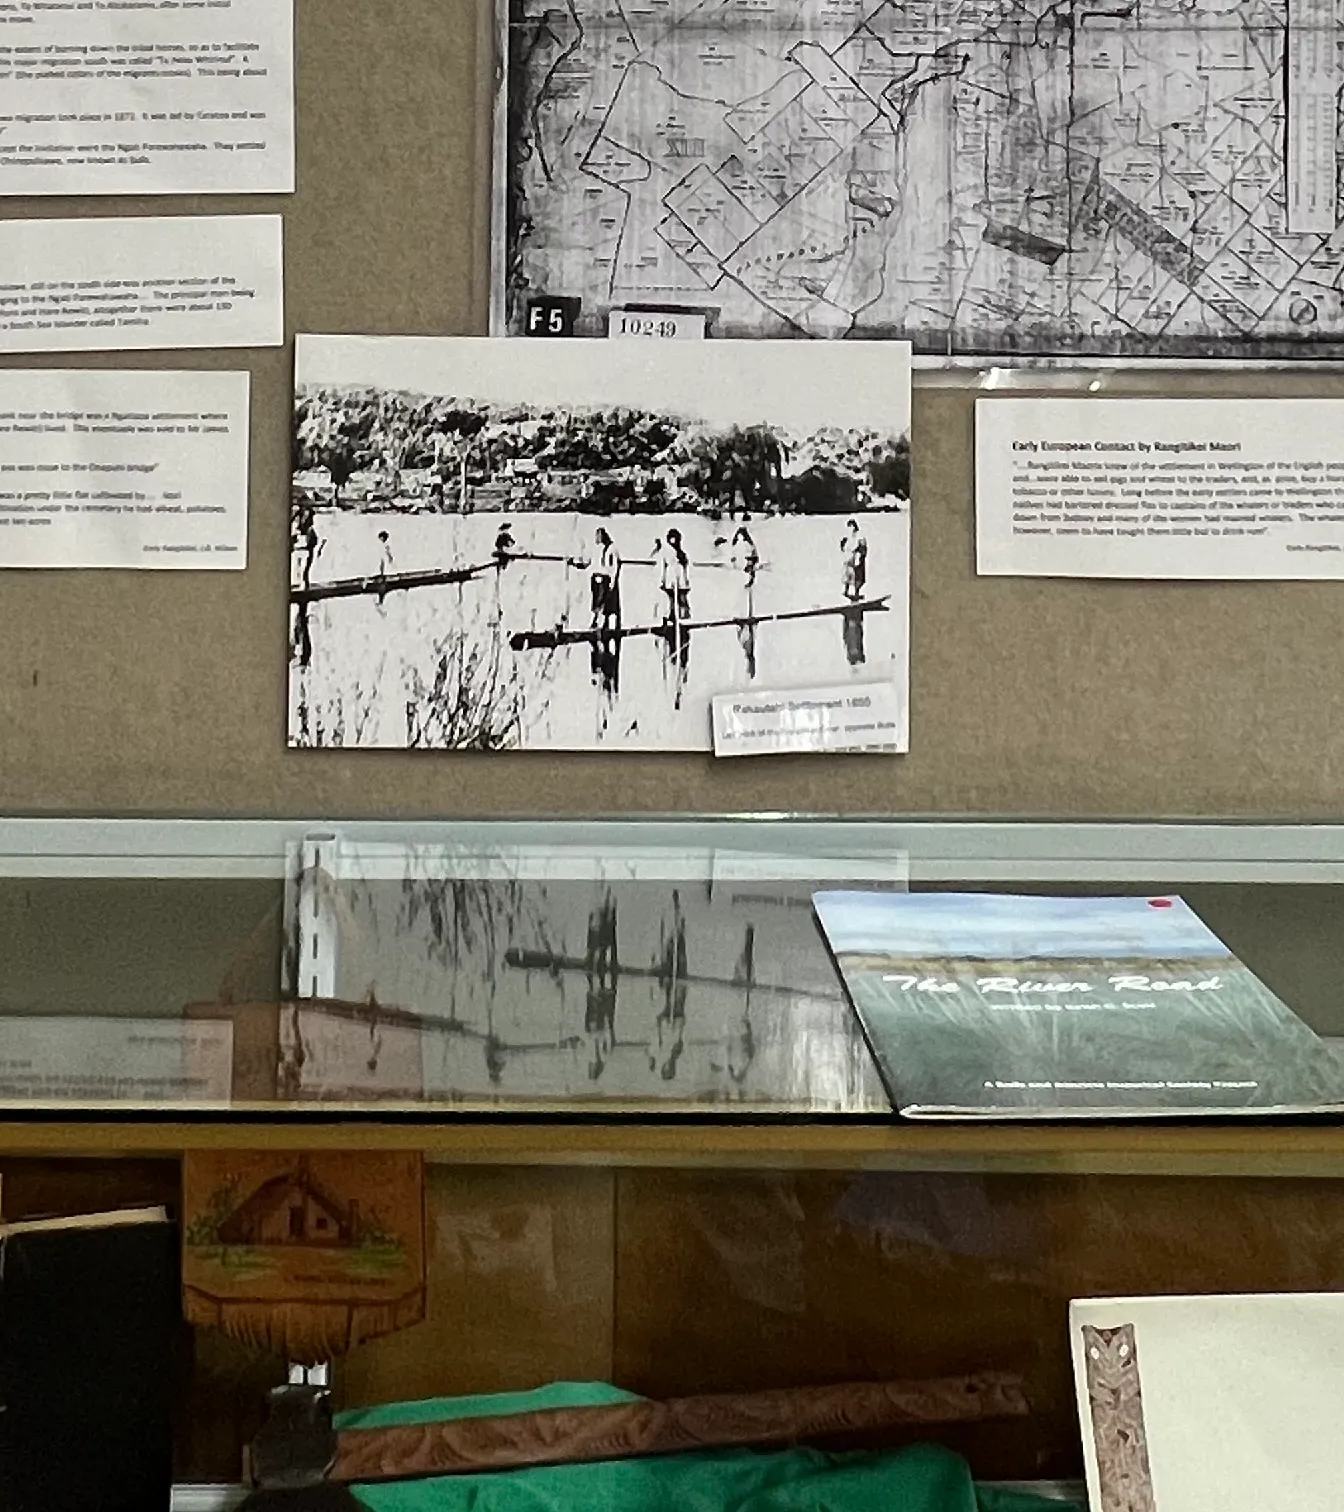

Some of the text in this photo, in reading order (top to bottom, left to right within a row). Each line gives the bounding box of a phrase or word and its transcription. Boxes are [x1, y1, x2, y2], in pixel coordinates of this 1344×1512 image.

[1041, 441, 1092, 453] European
[1094, 441, 1135, 451] Contact
[1138, 441, 1152, 453] by
[882, 974, 1224, 993] The River Road
